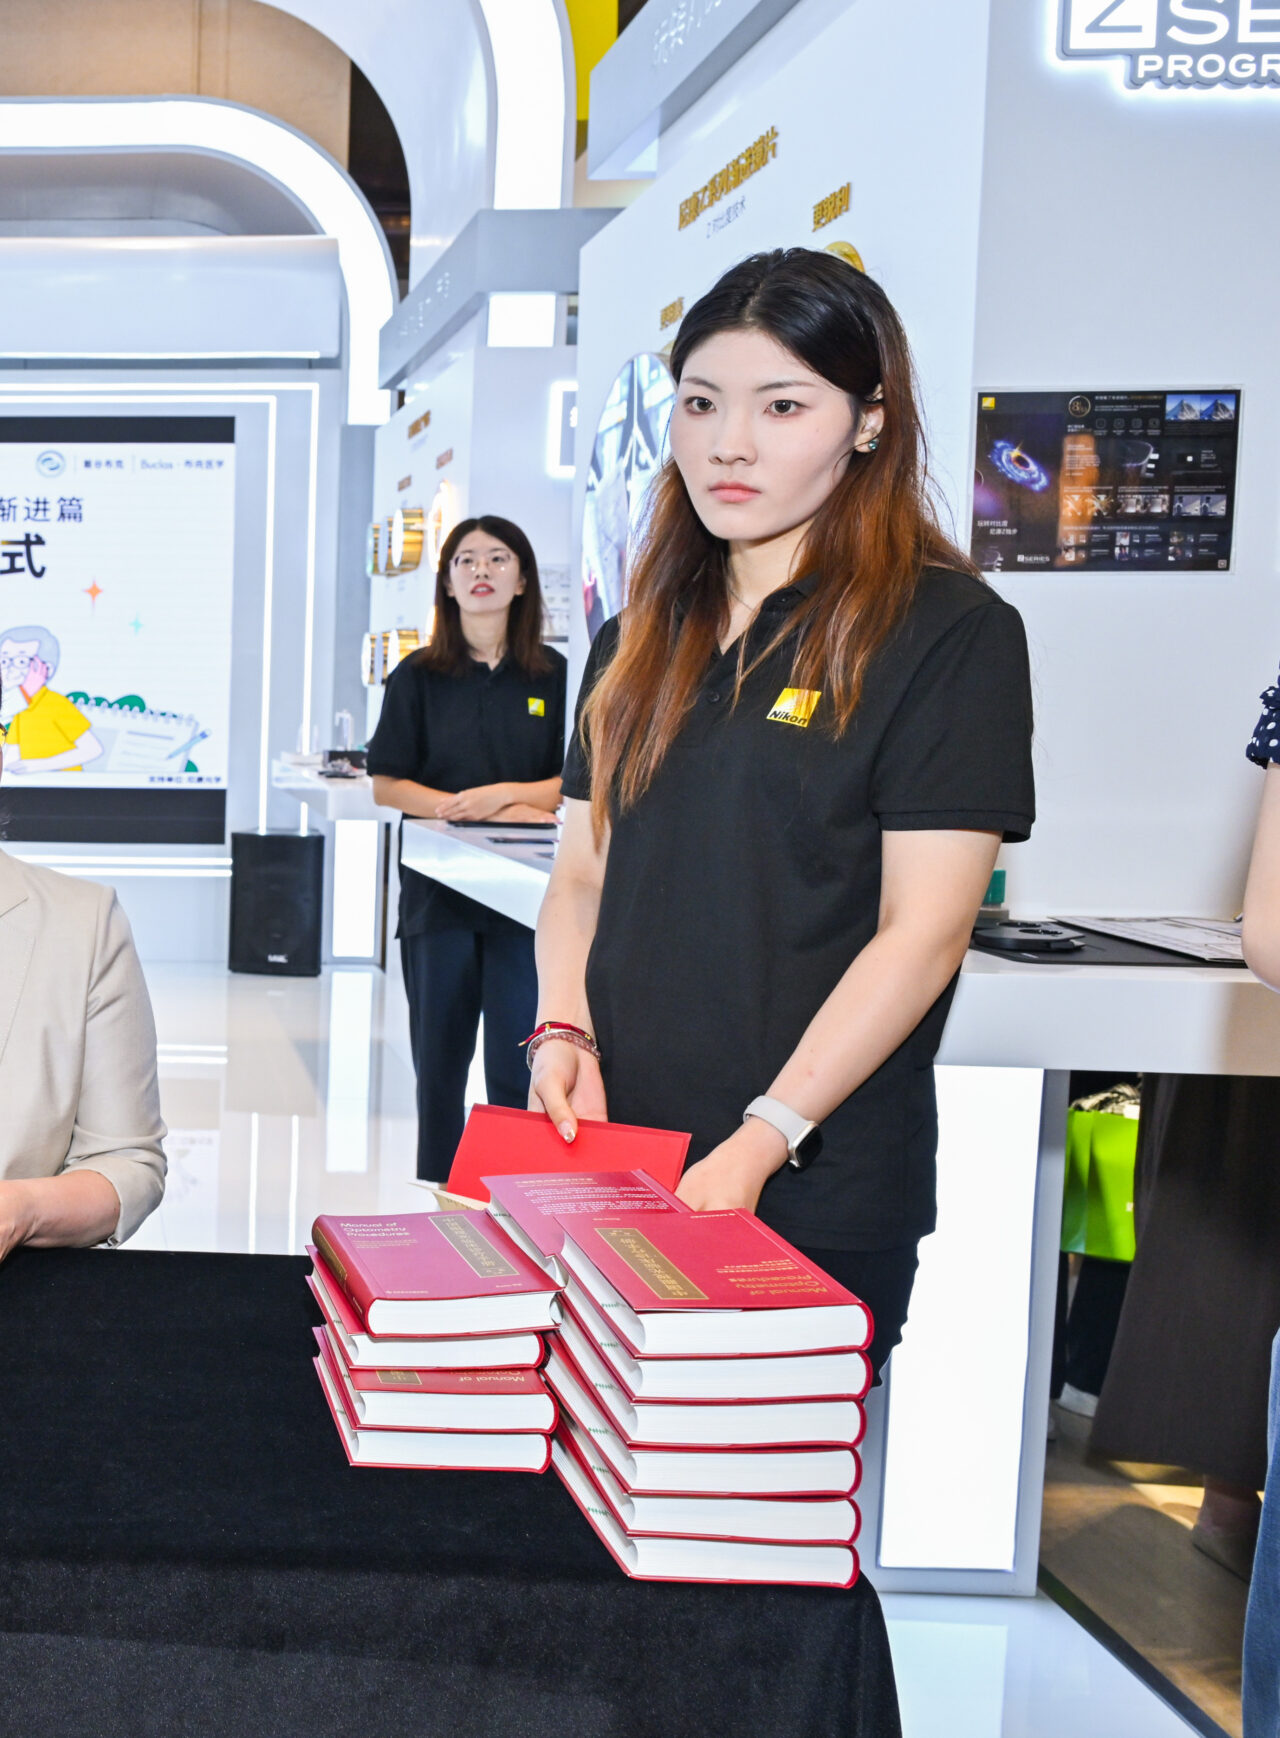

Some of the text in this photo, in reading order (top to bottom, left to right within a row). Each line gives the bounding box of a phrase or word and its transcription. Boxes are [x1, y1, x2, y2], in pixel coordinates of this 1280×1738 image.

[770, 710, 808, 725] Nikon
[735, 1281, 821, 1290] Optometry
[769, 1288, 828, 1296] Manual
